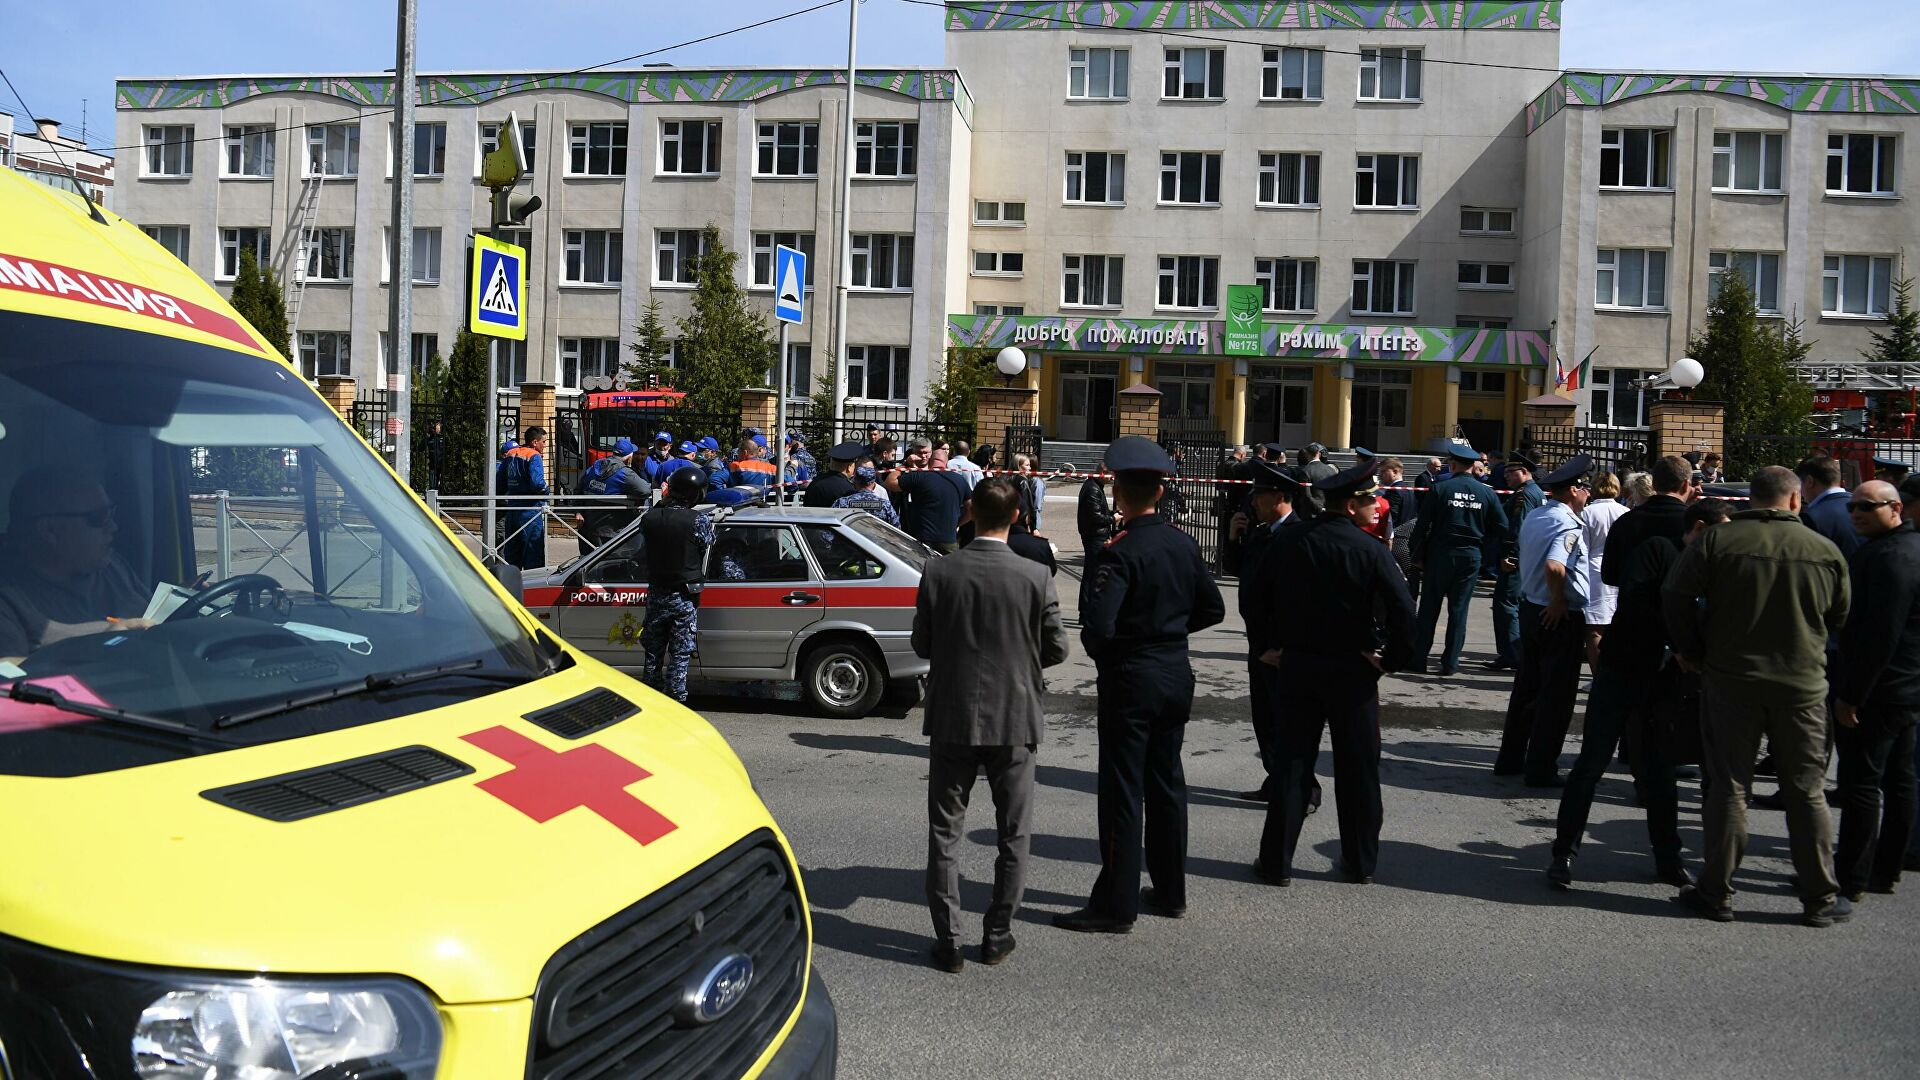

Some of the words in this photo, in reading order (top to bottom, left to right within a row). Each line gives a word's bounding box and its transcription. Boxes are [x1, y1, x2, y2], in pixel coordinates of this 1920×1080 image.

[0, 257, 195, 324] МАЦИЯ
[1014, 325, 1072, 343] ДОБРО
[1088, 327, 1208, 346] ПОЖАЛОВАТЬ
[1228, 340, 1258, 351] №175
[1359, 334, 1424, 352] ИТЕГЕЗ
[1454, 492, 1476, 501] МЧС
[1447, 500, 1482, 510] РОССИИ
